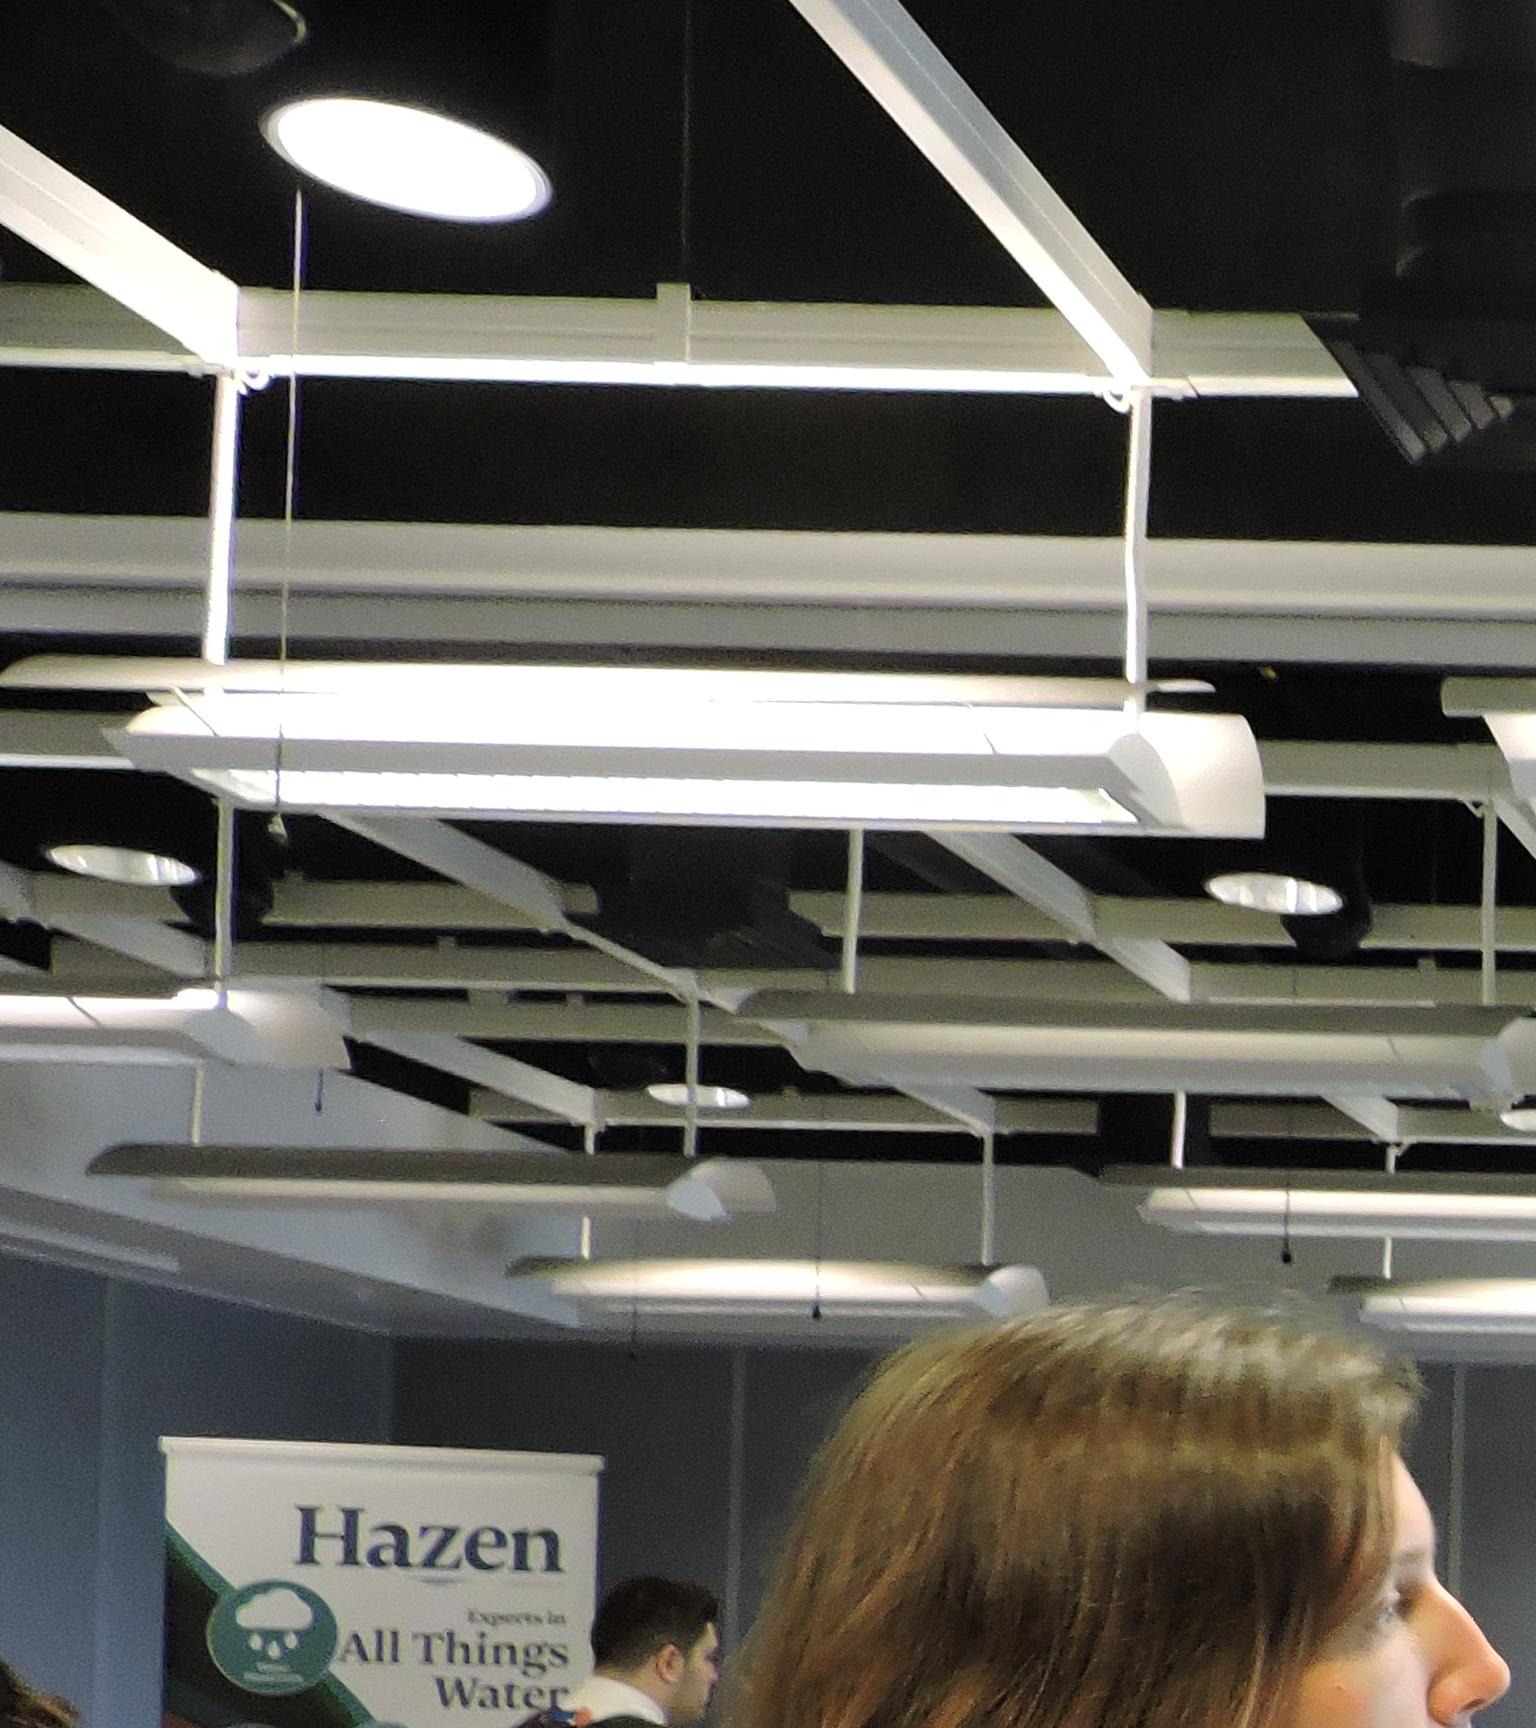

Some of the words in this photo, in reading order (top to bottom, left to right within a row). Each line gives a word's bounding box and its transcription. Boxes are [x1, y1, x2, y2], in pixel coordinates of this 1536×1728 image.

[294, 1503, 565, 1573] Hazen
[467, 1608, 543, 1629] Experts
[547, 1609, 567, 1625] in
[338, 1628, 400, 1664] All
[412, 1631, 570, 1680] Things
[433, 1674, 570, 1712] Water
